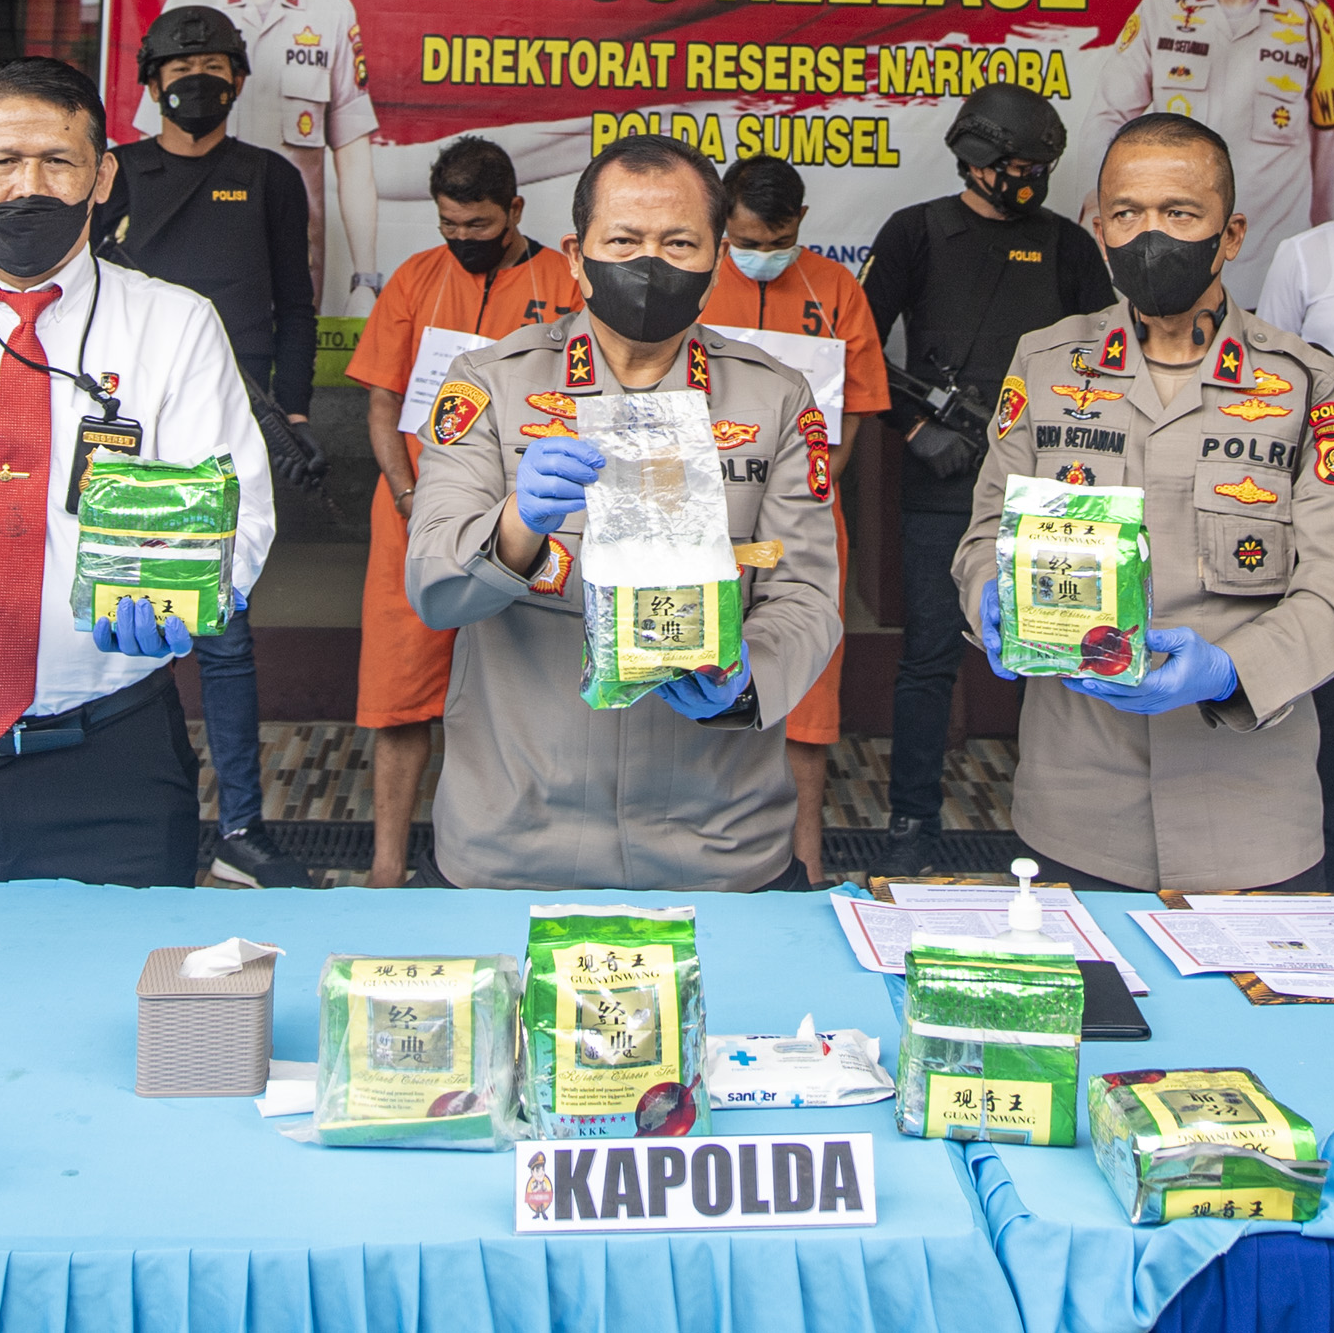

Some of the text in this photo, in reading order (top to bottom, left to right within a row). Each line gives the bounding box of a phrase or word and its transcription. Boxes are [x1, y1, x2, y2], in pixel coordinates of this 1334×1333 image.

[286, 49, 328, 68] POLRI
[422, 34, 1070, 98] DIREKTORAT RESERSE NARKOBA
[1260, 48, 1308, 69] POLRI
[736, 115, 899, 167] SUMSEL
[212, 190, 247, 201] POLISI
[1009, 250, 1042, 262] POLISI
[802, 300, 838, 336] 5
[444, 384, 485, 406] BARESKRIM
[1036, 426, 1125, 454] RUDI SETIAWAN
[1202, 438, 1297, 467] POLRI
[1029, 533, 1105, 545] GUANYINWANG
[1038, 522, 1096, 535] 观音王
[1045, 555, 1083, 603] 经典
[647, 595, 685, 643] 经典
[374, 965, 446, 978] 观音王
[578, 951, 646, 973] 观音王
[363, 979, 458, 987] GUANYINWANG
[570, 971, 661, 984] GUANYINWANG
[388, 1005, 430, 1064] 经典
[594, 1001, 640, 1059] 经典
[401, 1074, 440, 1085] Chinese
[444, 1074, 468, 1083] Tea
[558, 1065, 677, 1083] Refined Chinese Tea
[953, 1089, 1024, 1113] 观音王
[1177, 1128, 1276, 1144] GUANYINWANG
[554, 1141, 863, 1220] KAPOLDA
[1190, 1199, 1265, 1218] 观音王
